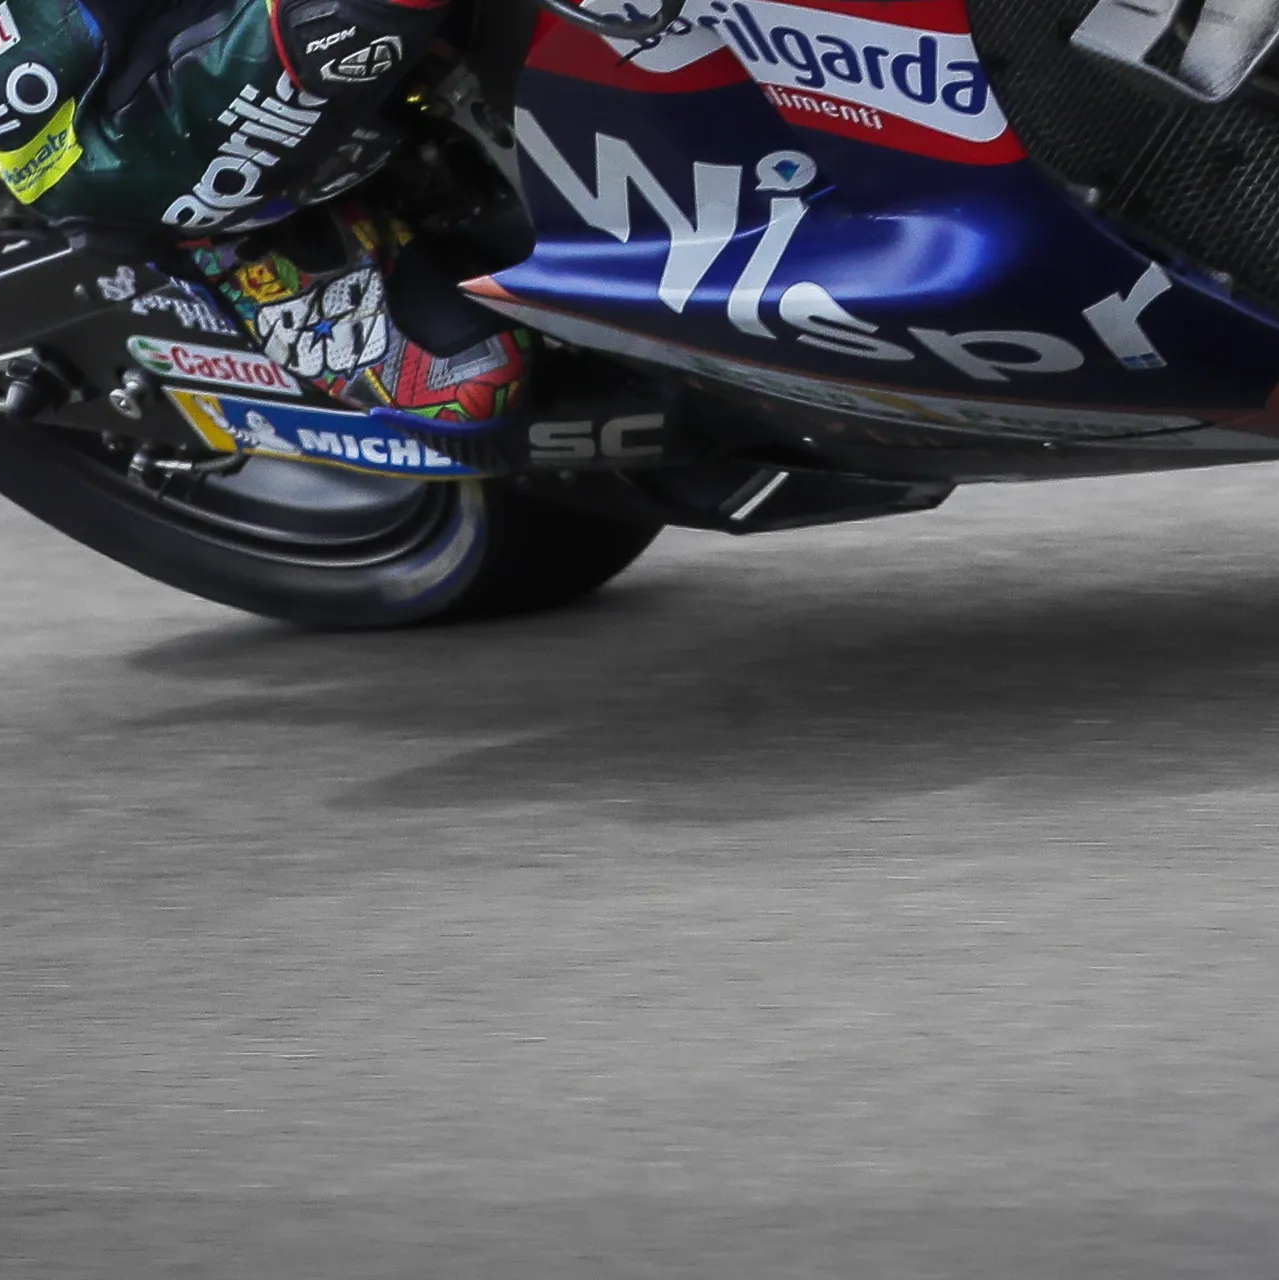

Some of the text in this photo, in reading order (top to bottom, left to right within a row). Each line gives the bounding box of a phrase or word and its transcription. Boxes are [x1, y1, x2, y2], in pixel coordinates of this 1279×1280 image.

[764, 84, 883, 130] limenti
[515, 106, 1172, 383] Wispr
[170, 344, 293, 390] Castrol
[298, 427, 462, 468] MICHE
[528, 412, 665, 460] SC
